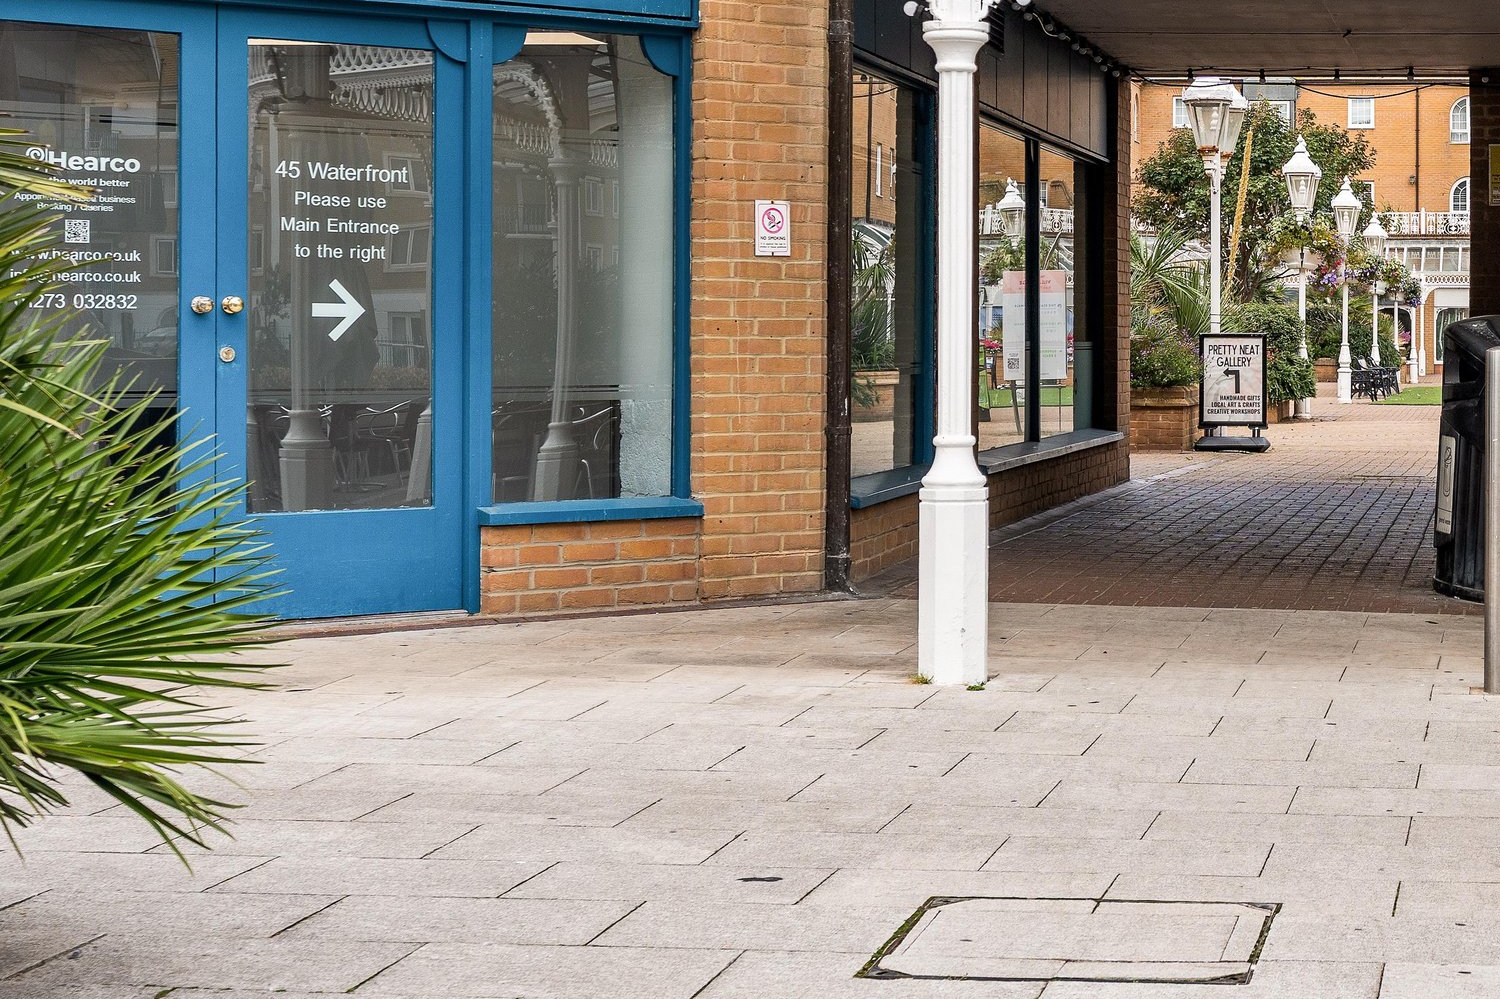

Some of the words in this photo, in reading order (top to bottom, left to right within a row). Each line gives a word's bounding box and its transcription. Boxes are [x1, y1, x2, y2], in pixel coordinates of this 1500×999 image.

[48, 151, 141, 173] Hearco
[275, 160, 300, 179] 45
[307, 161, 408, 183] Waterfront
[68, 178, 97, 186] world
[99, 178, 130, 187] better
[14, 192, 69, 202] Appoin
[99, 196, 136, 204] business
[294, 191, 351, 207] Please
[357, 196, 387, 209] use
[281, 216, 320, 232] Main
[327, 218, 399, 235] Entrance
[11, 248, 141, 262] w.hearco.co.uk
[294, 243, 310, 258] to
[317, 243, 343, 259] the
[350, 245, 386, 263] right
[10, 268, 141, 283] inhearco.co.uk
[14, 293, 66, 309] 273
[73, 293, 138, 310] 032832
[1208, 344, 1238, 355] PRETTY
[1239, 344, 1260, 355] NEAT
[1216, 357, 1252, 367] GALLERY
